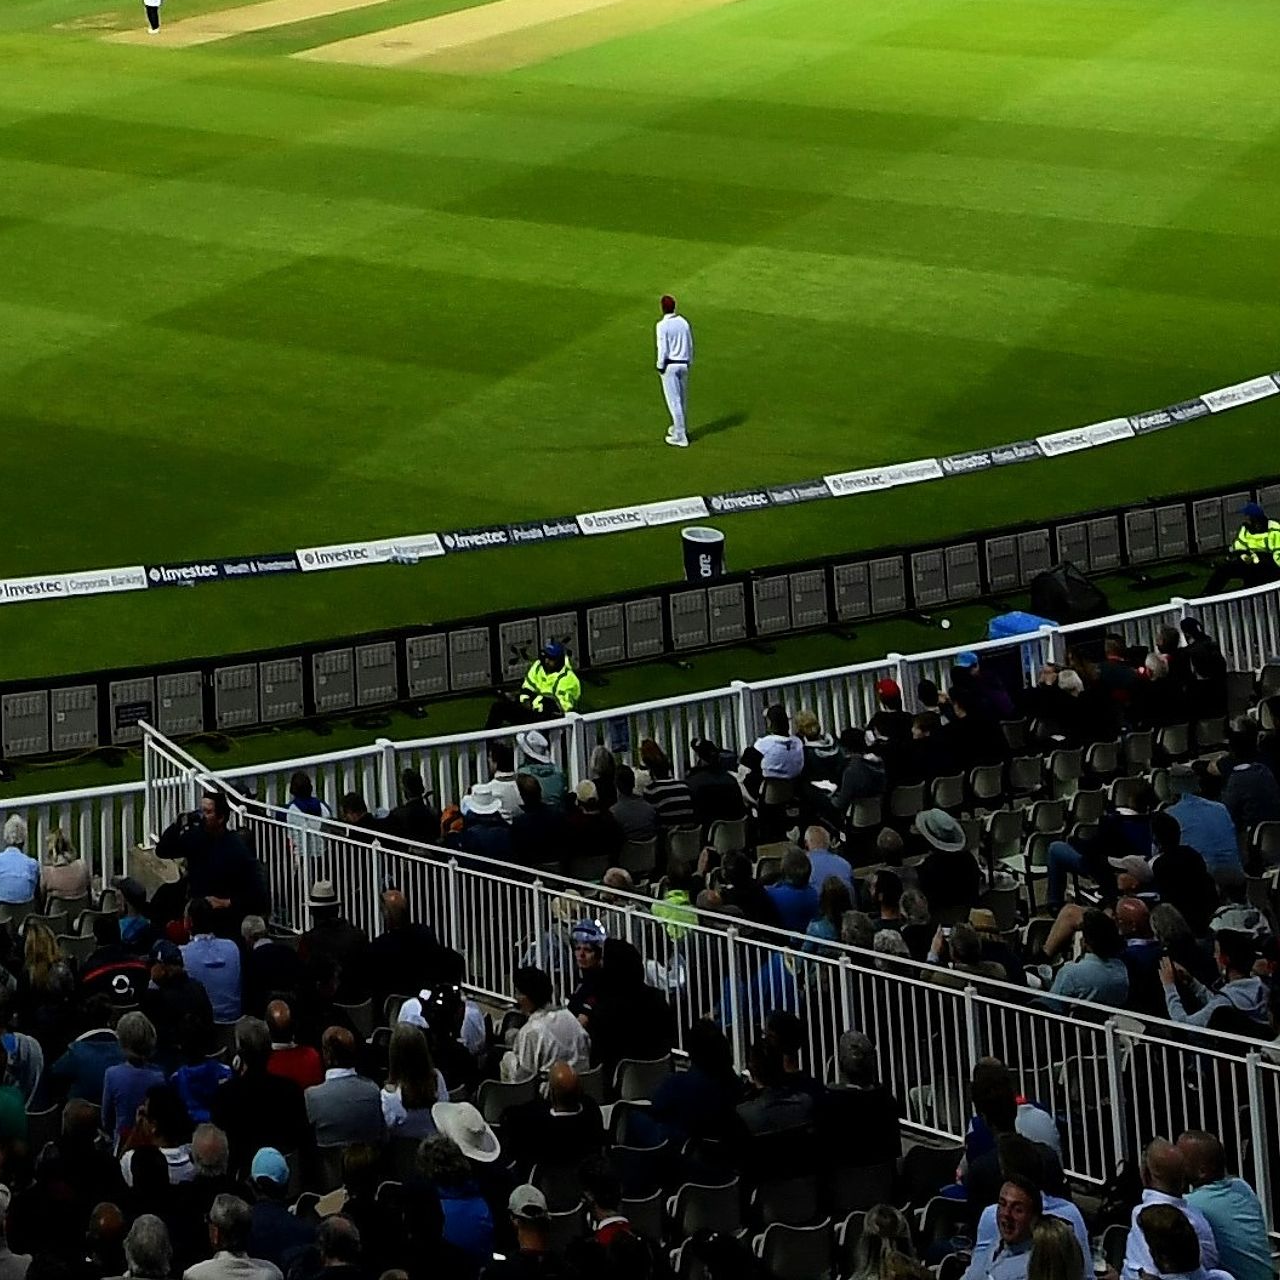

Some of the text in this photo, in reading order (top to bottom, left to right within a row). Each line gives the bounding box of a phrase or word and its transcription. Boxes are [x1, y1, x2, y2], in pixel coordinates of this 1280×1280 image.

[454, 529, 508, 549] Investec
[314, 546, 369, 564] Investec
[159, 562, 219, 582] Investec
[3, 579, 63, 598] Investec
